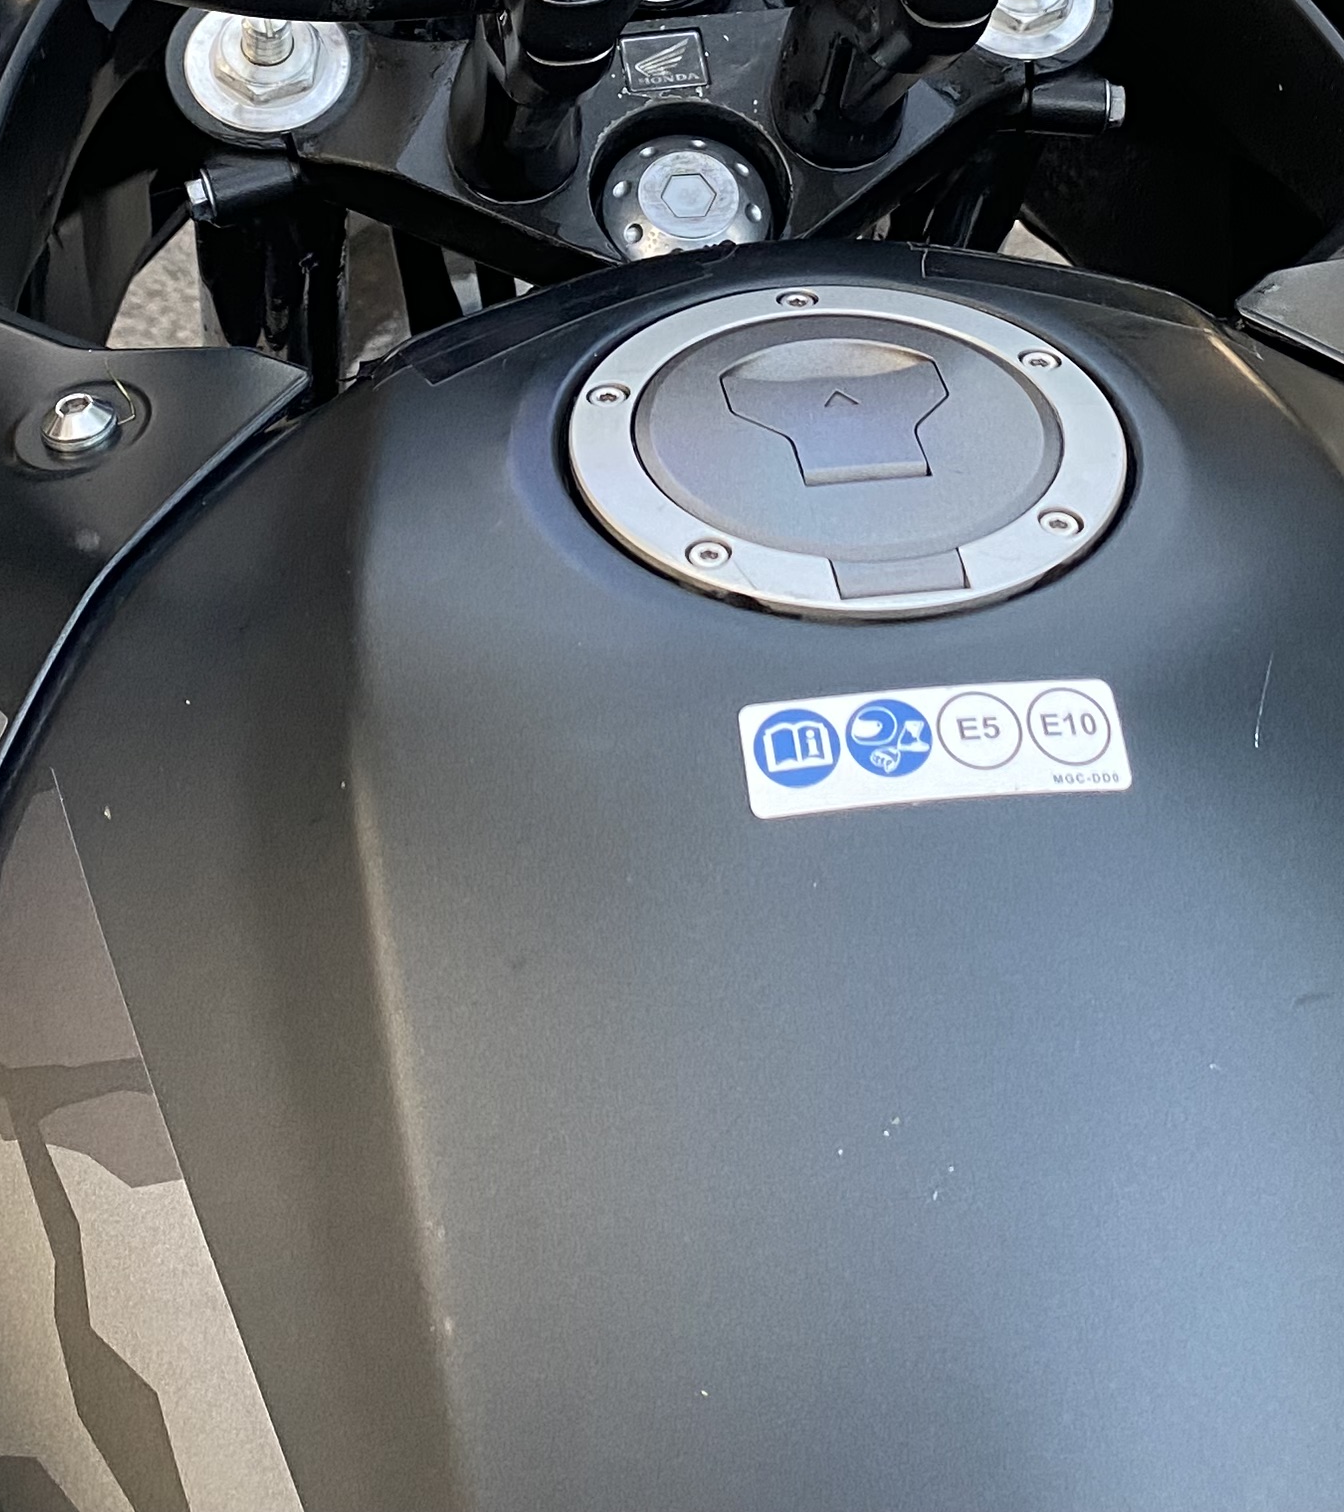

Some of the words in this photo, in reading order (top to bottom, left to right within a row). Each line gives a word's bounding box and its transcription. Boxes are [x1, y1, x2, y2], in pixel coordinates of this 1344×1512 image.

[638, 72, 700, 85] HONDA
[956, 716, 1001, 741] E5
[1040, 712, 1098, 738] E10
